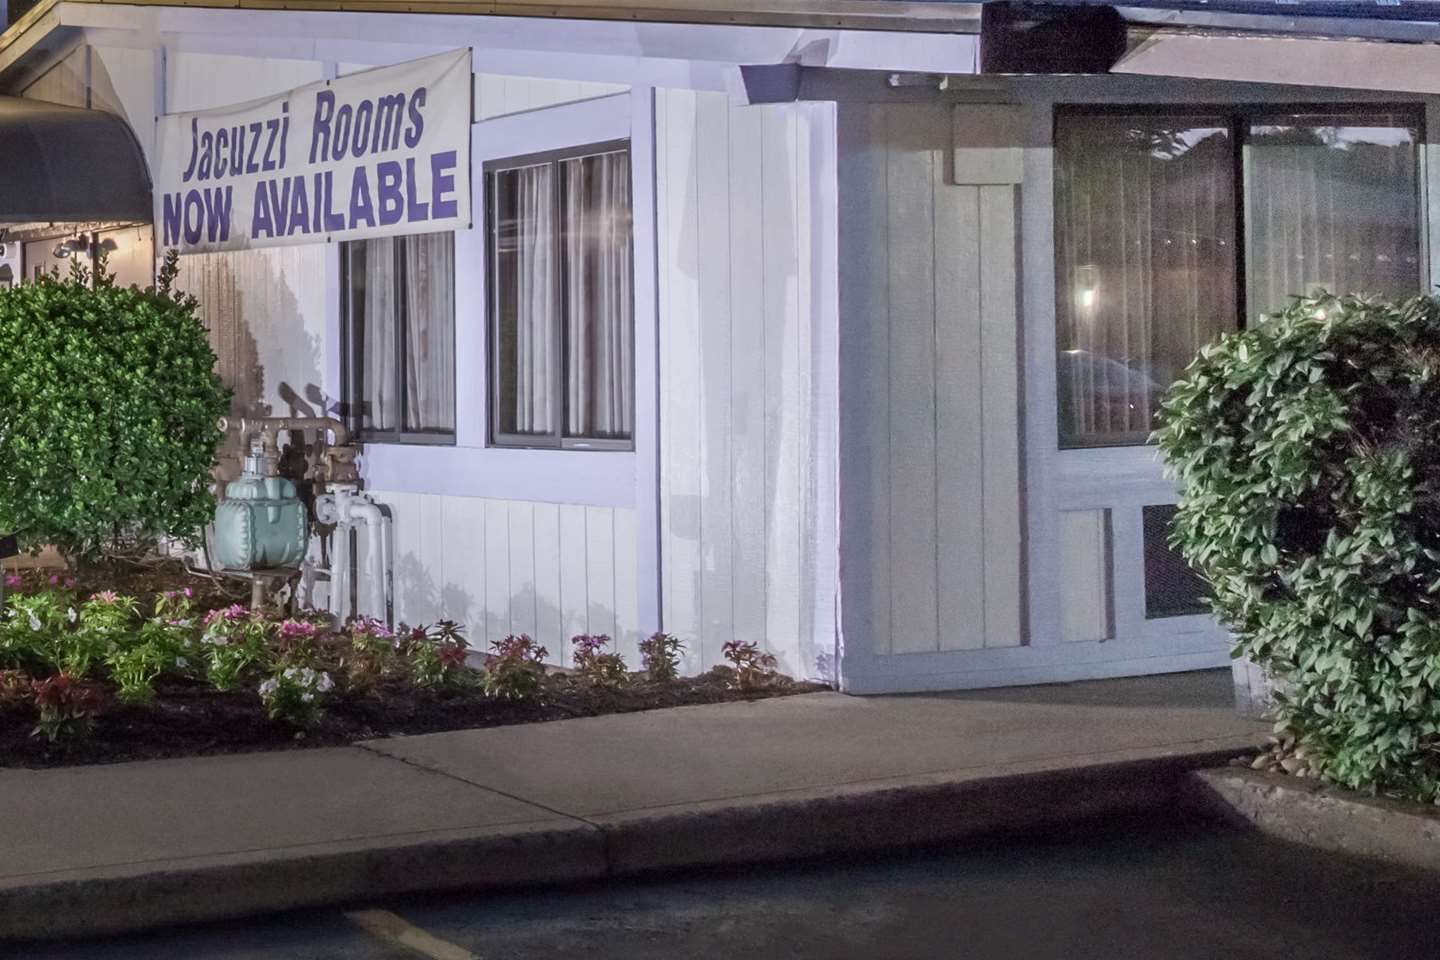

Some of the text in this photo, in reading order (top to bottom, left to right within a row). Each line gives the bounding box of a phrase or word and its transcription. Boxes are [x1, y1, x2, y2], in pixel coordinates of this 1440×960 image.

[183, 87, 427, 182] Jacuzzi Rooms
[163, 150, 458, 246] NOW AVAILABLE
